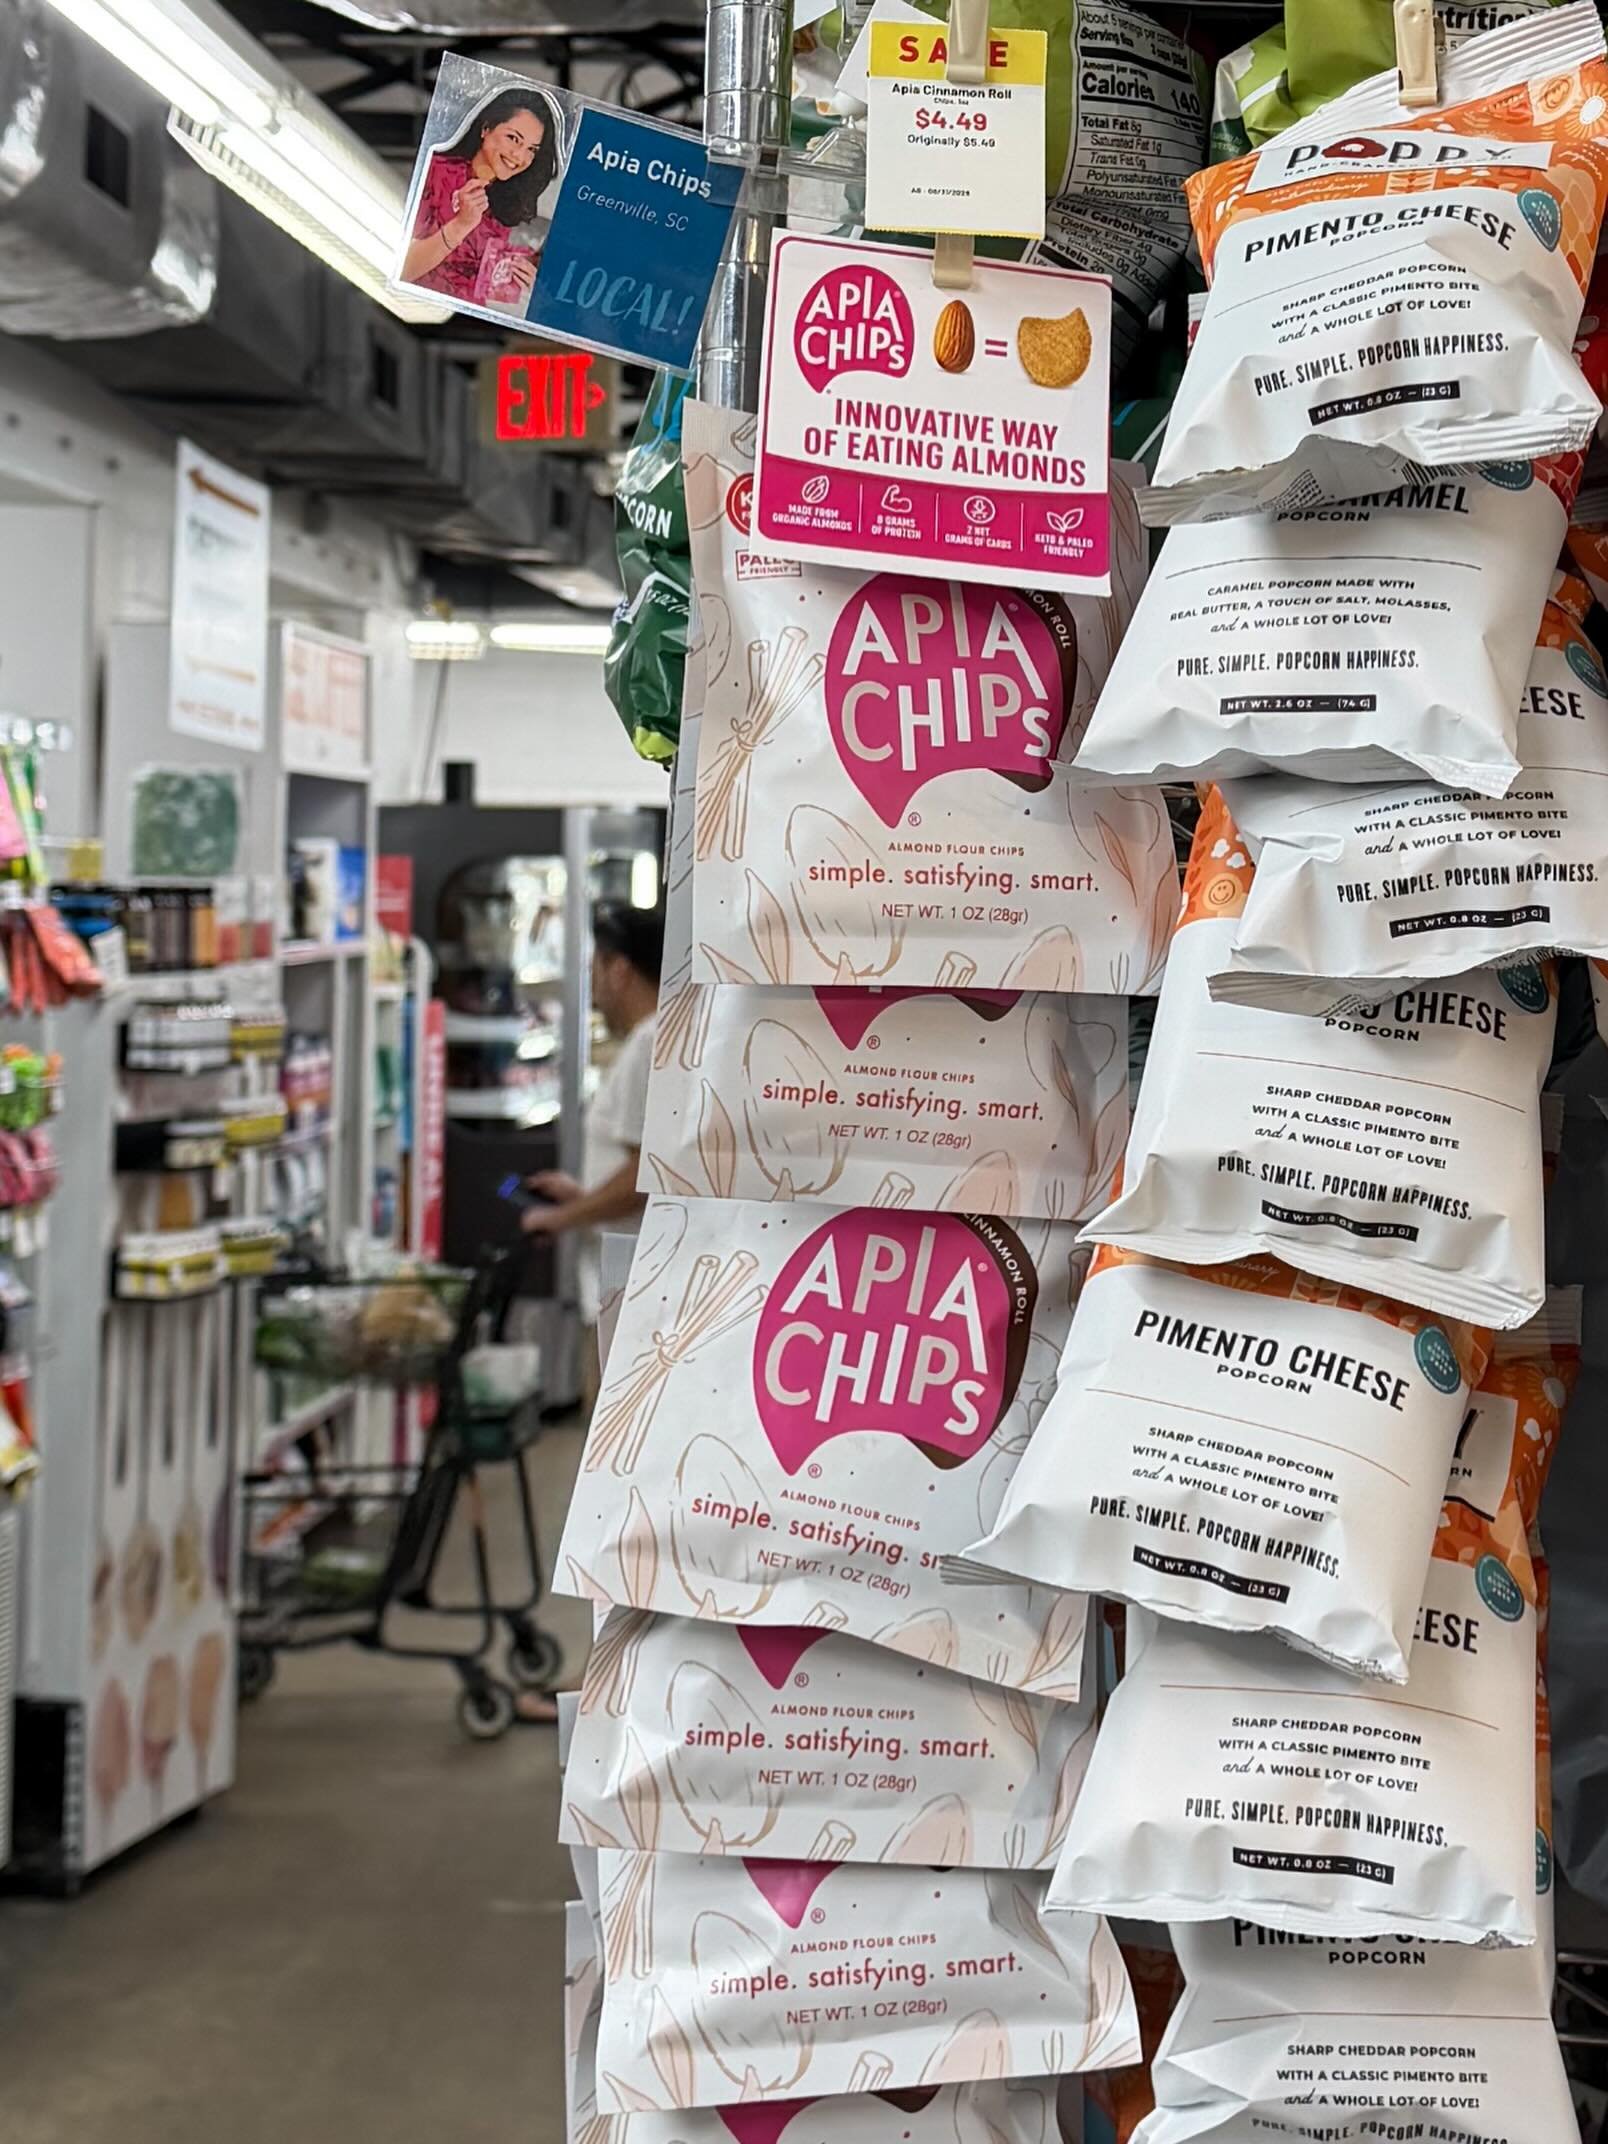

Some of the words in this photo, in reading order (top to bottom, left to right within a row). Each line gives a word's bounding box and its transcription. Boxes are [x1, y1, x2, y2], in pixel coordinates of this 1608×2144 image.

[900, 37, 1008, 67] SAE
[892, 83, 920, 96] Apia
[923, 85, 985, 98] Cinnamon
[989, 88, 1012, 99] Roll
[1081, 72, 1155, 101] Calories
[1171, 89, 1200, 114] 140
[916, 108, 987, 131] $4.49
[1081, 116, 1111, 128] Total
[1113, 118, 1129, 131] Fat
[908, 135, 960, 148] Originally
[963, 137, 995, 148] $5.49
[586, 142, 640, 175] Apia
[647, 159, 711, 198] Chips
[665, 212, 689, 231] SC
[1055, 201, 1087, 217] Total
[1091, 209, 1180, 249] Carbohydrate
[1245, 211, 1384, 262] PIMENTO
[1397, 204, 1518, 251] CHEESE
[1330, 220, 1425, 247] POPCORN
[556, 260, 694, 335] LOCAL!
[805, 276, 904, 342] APIA
[1255, 370, 1293, 396] PURE.
[1296, 353, 1353, 384] SIMPLE.
[1358, 338, 1419, 369] POPCORN
[1424, 332, 1509, 357] HAPPINESS.
[496, 354, 594, 441] EXIT
[835, 398, 994, 444] INNOVATIVE
[1003, 419, 1058, 451] WAY
[804, 427, 838, 455] OF
[848, 432, 943, 470] EATING
[952, 442, 1086, 487] ALMONDS
[773, 513, 809, 526] ORGANIC
[811, 517, 852, 531] ALMONDS
[789, 504, 814, 515] MADE
[816, 507, 839, 518] FROM
[885, 516, 916, 528] GRAMS
[1277, 510, 1371, 523] POPCORN
[871, 525, 882, 535] OF
[884, 526, 921, 539] PROTEIN
[945, 534, 973, 545] GRAMS
[975, 536, 984, 547] OF
[987, 538, 1012, 549] CARBS
[975, 526, 990, 536] NET
[1035, 534, 1056, 545] KETO
[1067, 536, 1093, 548] PALEO
[1044, 545, 1084, 558] FRIENDLY
[841, 581, 1048, 700] APIA
[1050, 616, 1071, 648] ROLL
[1177, 656, 1214, 678] PURE.
[1218, 652, 1270, 674] SIMPLE.
[1276, 650, 1341, 671] POPCORN
[1347, 648, 1419, 671] HAPPINESS.
[888, 843, 941, 853] ALMOND
[947, 844, 985, 855] FLOUR
[990, 846, 1025, 856] CHIPS
[809, 859, 893, 888] simple.
[904, 862, 1020, 894] satisfying.
[1030, 866, 1098, 892] smart.
[1337, 883, 1377, 903] PURE.
[1383, 874, 1439, 898] SIMPLE.
[1444, 865, 1510, 887] POPCORN
[1516, 862, 1599, 884] HAPPINESS.
[882, 904, 914, 919] NET
[918, 904, 943, 919] WT.
[951, 907, 956, 919] 1
[962, 907, 984, 920] OZ
[988, 908, 1029, 925] (28gr)
[1324, 1017, 1420, 1042] POPCORN
[1394, 989, 1507, 1042] CHEESE
[763, 1079, 845, 1109] simple.
[856, 1087, 967, 1120] satisfying.
[977, 1101, 1044, 1120] smart.
[1266, 1085, 1312, 1100] SHARP
[1316, 1092, 1381, 1113] CHEDDAR
[1385, 1104, 1451, 1125] POPCORN
[781, 1226, 988, 1374] APIA
[1013, 1286, 1028, 1325] ROLL
[1134, 1310, 1279, 1367] PIMENTO
[1288, 1344, 1410, 1412] CHEESE
[1216, 1364, 1313, 1395] POPCORN
[780, 1489, 836, 1510] ALMOND
[841, 1503, 880, 1520] FLOUR
[884, 1514, 920, 1530] CHIPS
[692, 1493, 777, 1531] simple.
[788, 1517, 908, 1565] satisfying.
[757, 1549, 792, 1569] NET
[796, 1558, 821, 1574] WT.
[829, 1565, 834, 1576] 1
[840, 1567, 865, 1583] OZ
[867, 1572, 912, 1599] (28gr)
[771, 1704, 828, 1717] ALMOND
[833, 1707, 873, 1719] FLOUR
[878, 1709, 915, 1720] CHIPS
[685, 1723, 773, 1754] simple.
[785, 1727, 909, 1760] satisfying.
[920, 1738, 995, 1759] smart.
[1218, 1738, 1254, 1750] WITH
[1258, 1740, 1268, 1750] A
[1271, 1740, 1329, 1755] CLASSIC
[1332, 1747, 1396, 1764] PIMENTO
[1400, 1756, 1431, 1771] BITE
[758, 1770, 792, 1784] NET
[797, 1771, 825, 1785] WT.
[833, 1774, 838, 1785] 1
[845, 1773, 869, 1788] OZ
[873, 1774, 917, 1792] (28gr)
[1222, 1756, 1254, 1775] and
[1256, 1763, 1265, 1774] A
[1271, 1764, 1321, 1778] WHOLE
[1324, 1769, 1351, 1781] LOT
[1355, 1773, 1374, 1785] OF
[1378, 1776, 1419, 1792] LOVE!
[1185, 1798, 1225, 1820] PURE.
[1231, 1801, 1289, 1825] SIMPLE.
[1295, 1806, 1361, 1832] POPCORN
[1366, 1811, 1448, 1848] HAPPINESS.
[1240, 1852, 1263, 1866] NET
[1316, 1859, 1332, 1871] OZ
[1329, 1951, 1426, 1965] POPCORN
[710, 1966, 797, 1999] simple.
[808, 1958, 934, 1990] satisfying.
[946, 1952, 1023, 1977] smart.
[787, 2008, 819, 2024] NET
[825, 2006, 854, 2021] WT.
[861, 2005, 867, 2018] 1
[874, 2002, 899, 2017] OZ
[903, 1998, 948, 2015] (28gr)
